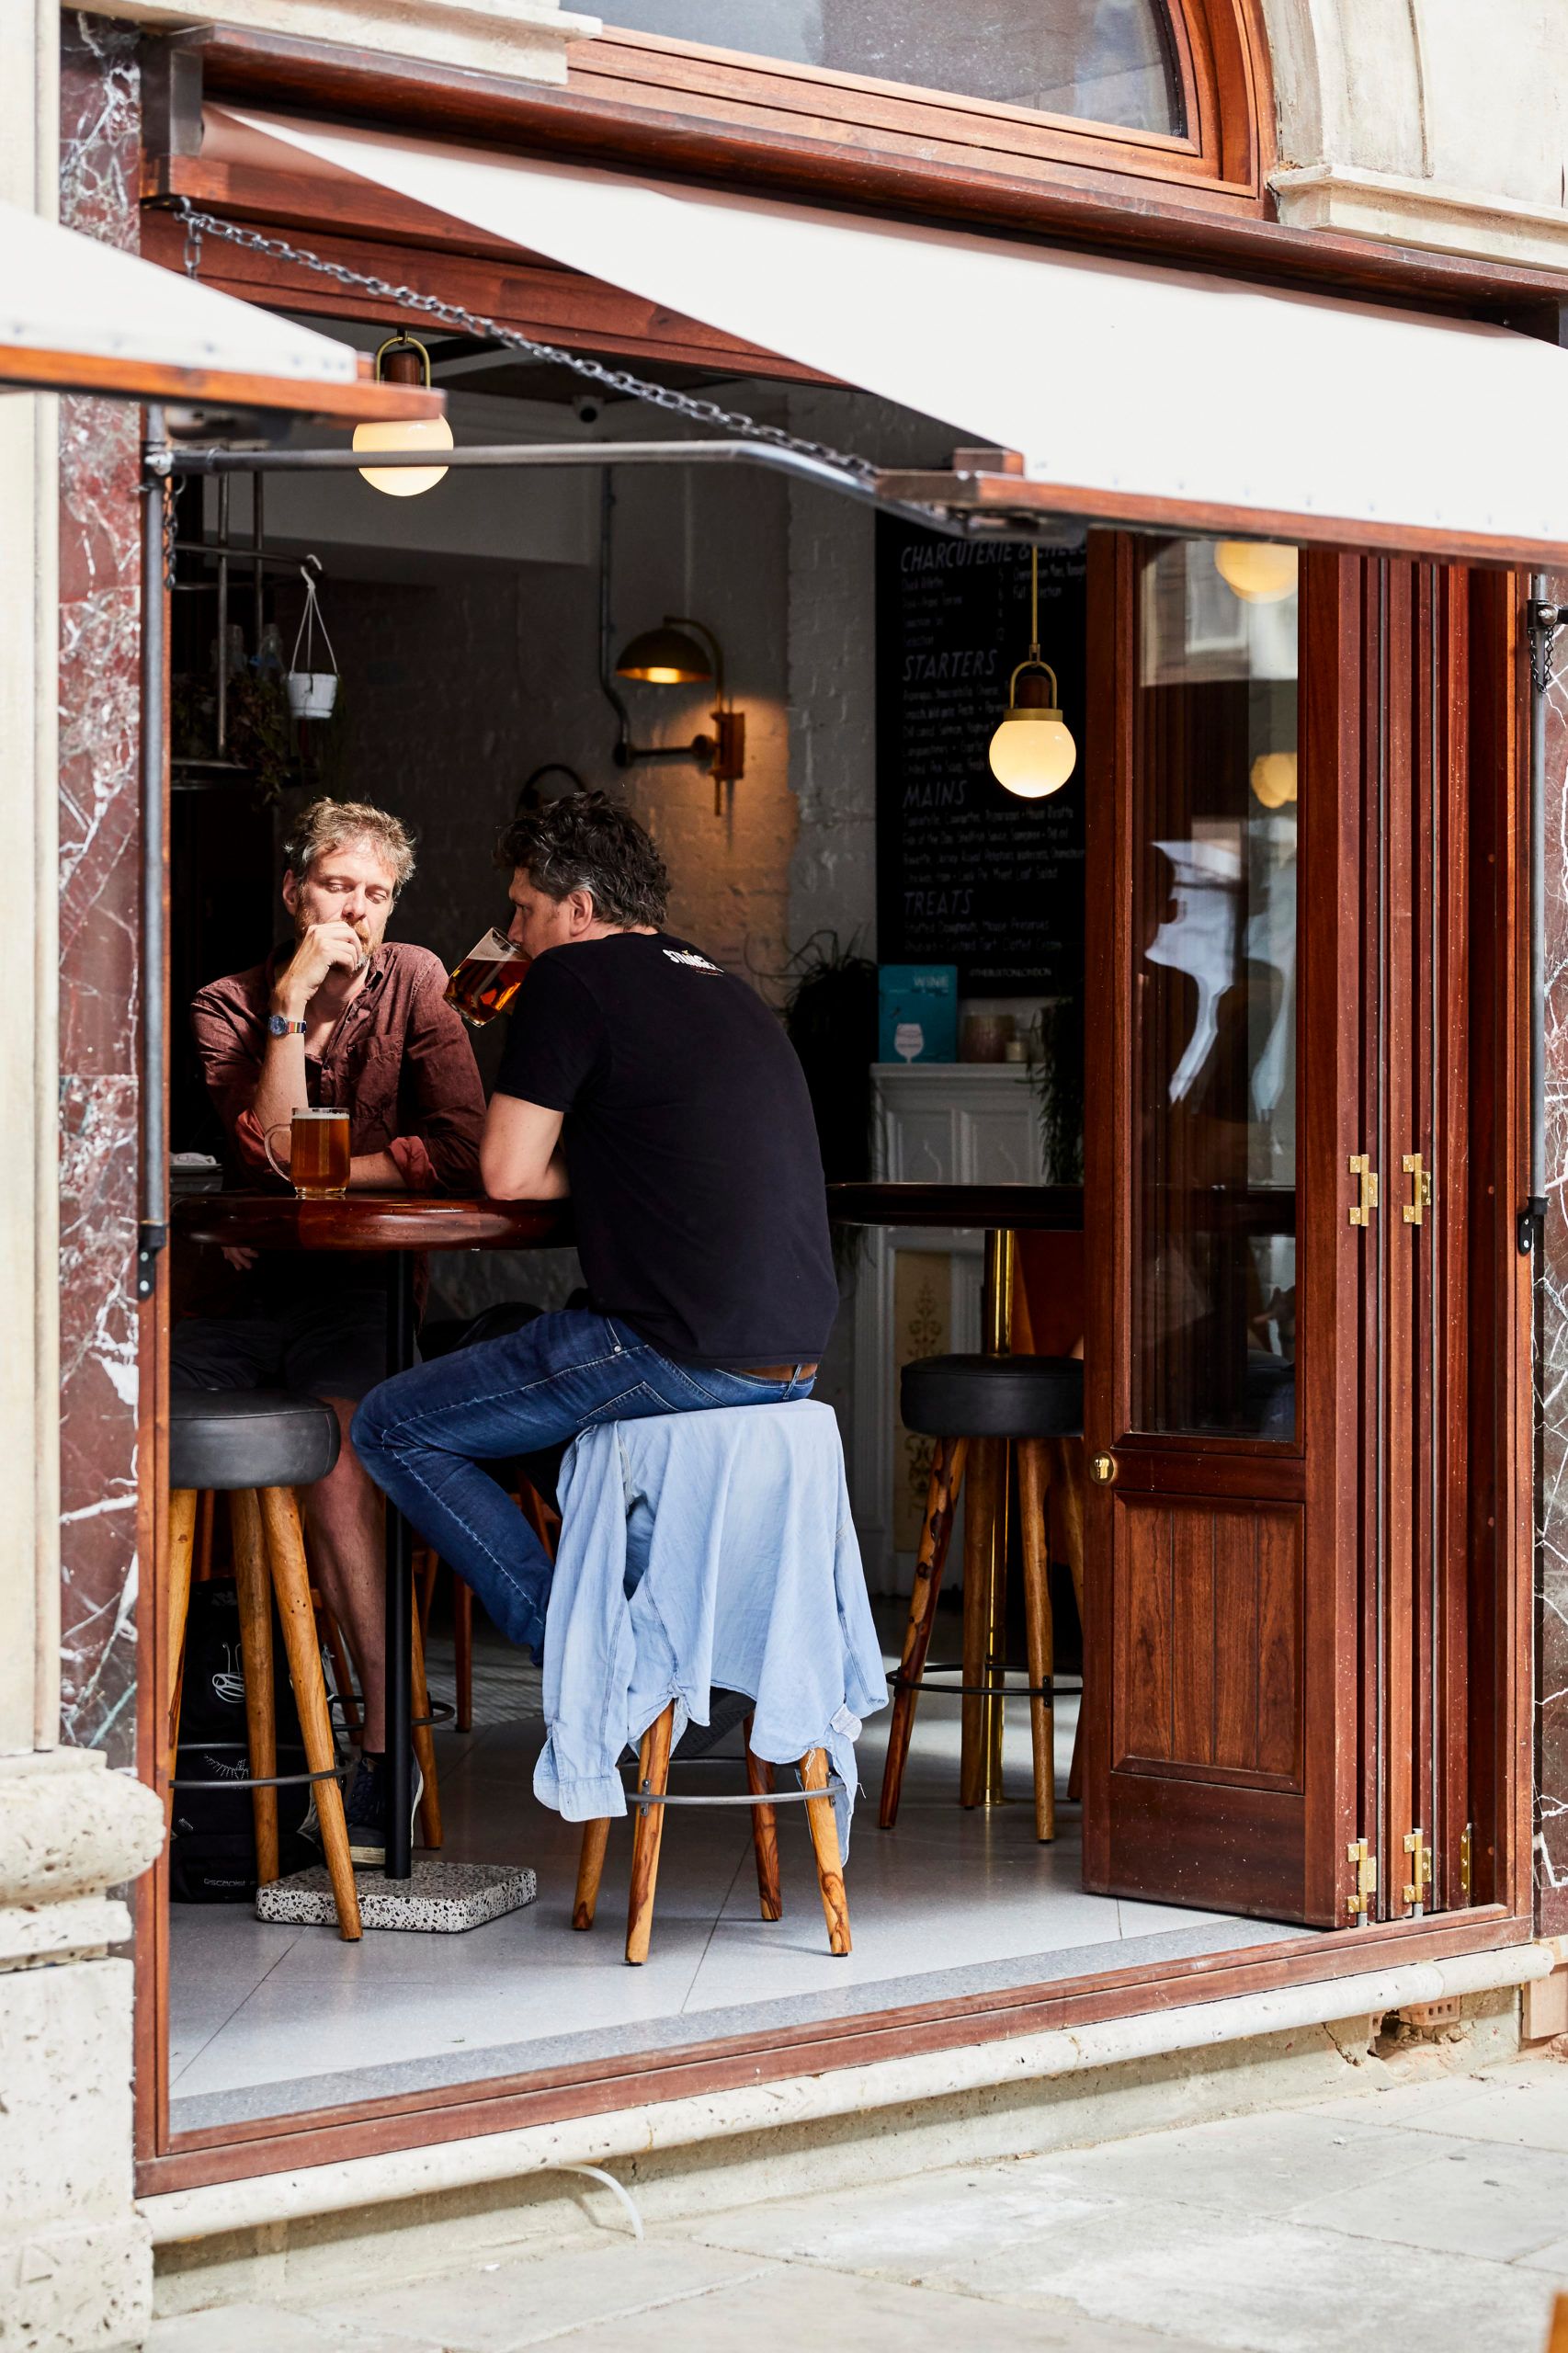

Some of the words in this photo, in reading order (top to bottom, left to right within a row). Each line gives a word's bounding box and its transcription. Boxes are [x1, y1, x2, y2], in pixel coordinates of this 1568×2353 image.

[901, 540, 1013, 573] CHARCUTERIE
[902, 648, 998, 682] STARTERS
[902, 779, 969, 809] MAINS
[903, 888, 975, 916] TREATS
[914, 976, 949, 987] WINE
